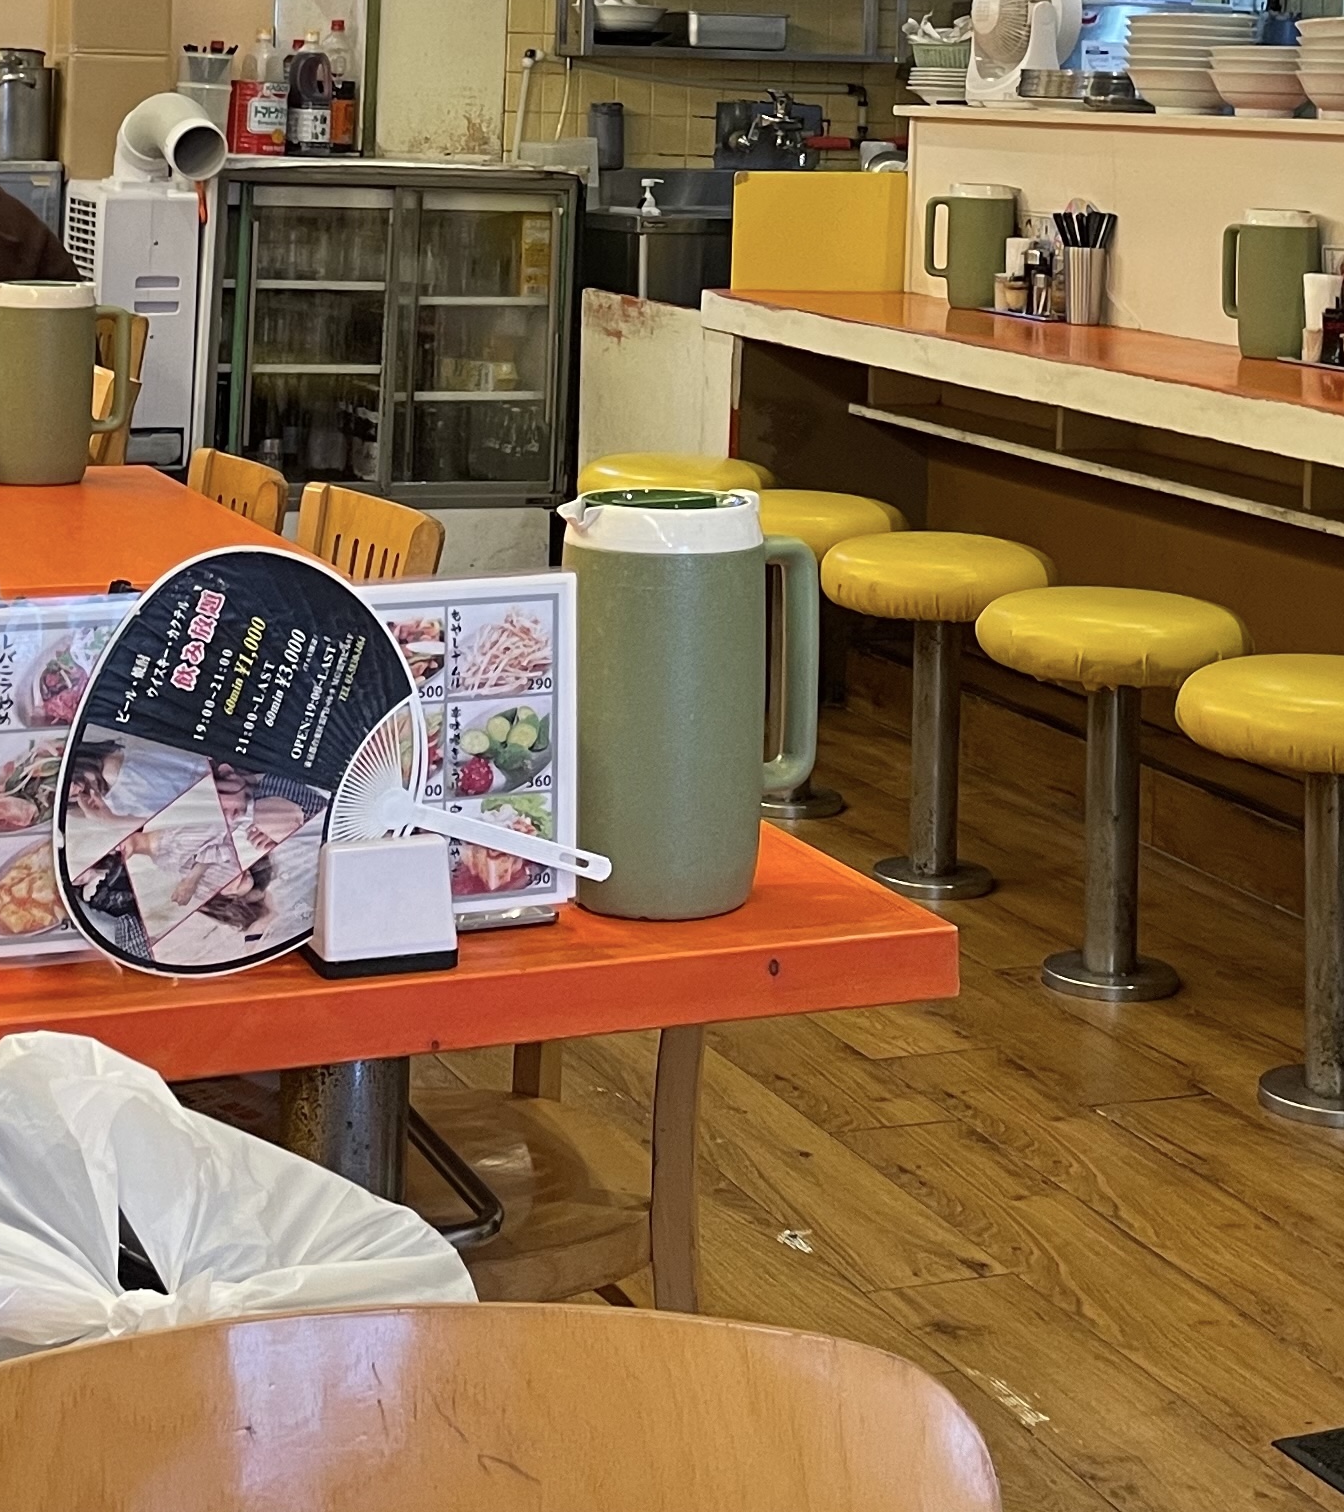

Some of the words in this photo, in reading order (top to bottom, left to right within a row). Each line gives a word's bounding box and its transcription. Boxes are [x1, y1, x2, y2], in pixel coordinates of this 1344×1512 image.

[170, 589, 226, 692] 飲み放題
[274, 628, 307, 689] ¥3,000
[528, 678, 552, 690] 290
[264, 689, 285, 728] 60min
[425, 785, 442, 797] 00
